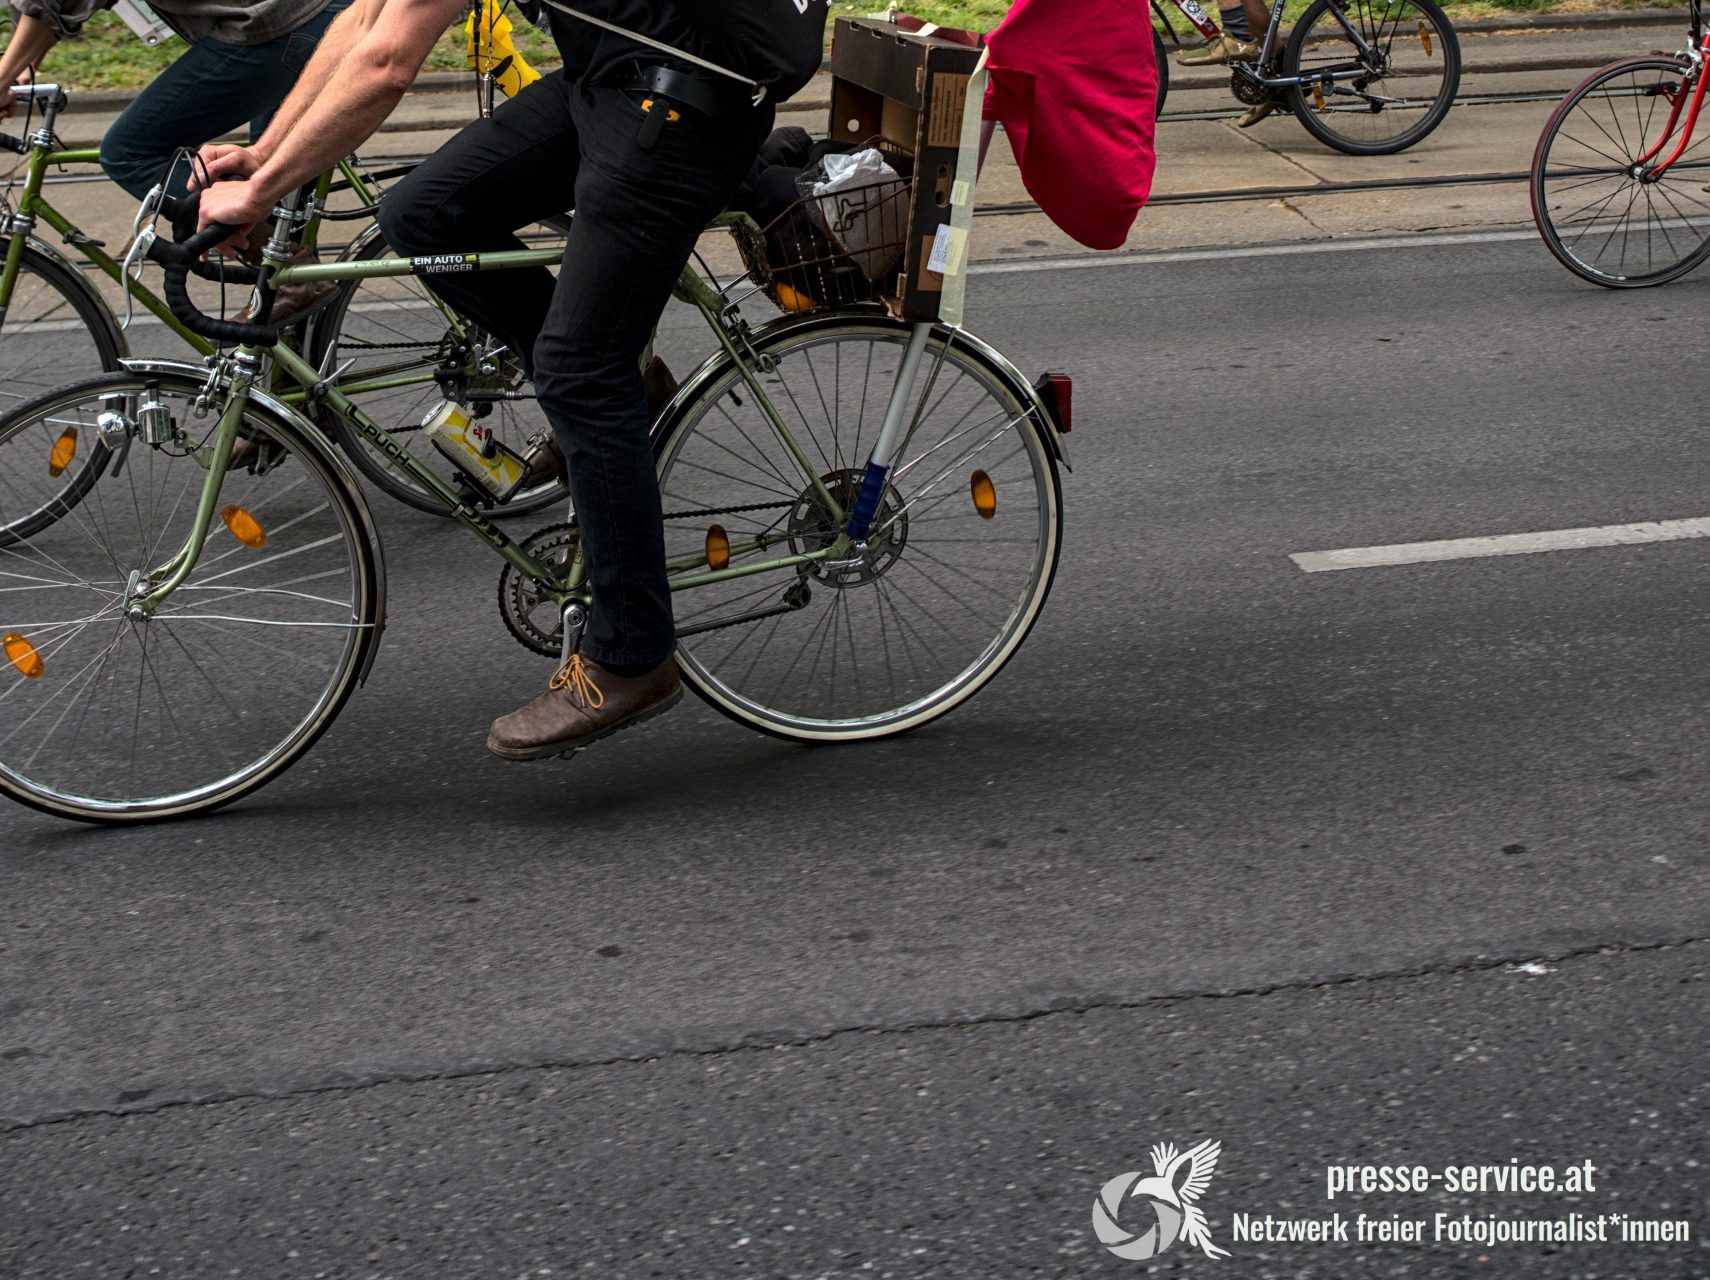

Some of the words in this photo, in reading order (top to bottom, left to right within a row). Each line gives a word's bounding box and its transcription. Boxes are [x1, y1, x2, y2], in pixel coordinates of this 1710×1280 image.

[414, 256, 432, 265] EIN
[434, 255, 463, 264] AUTO
[425, 263, 473, 273] WENIGER
[363, 423, 411, 466] PUCH
